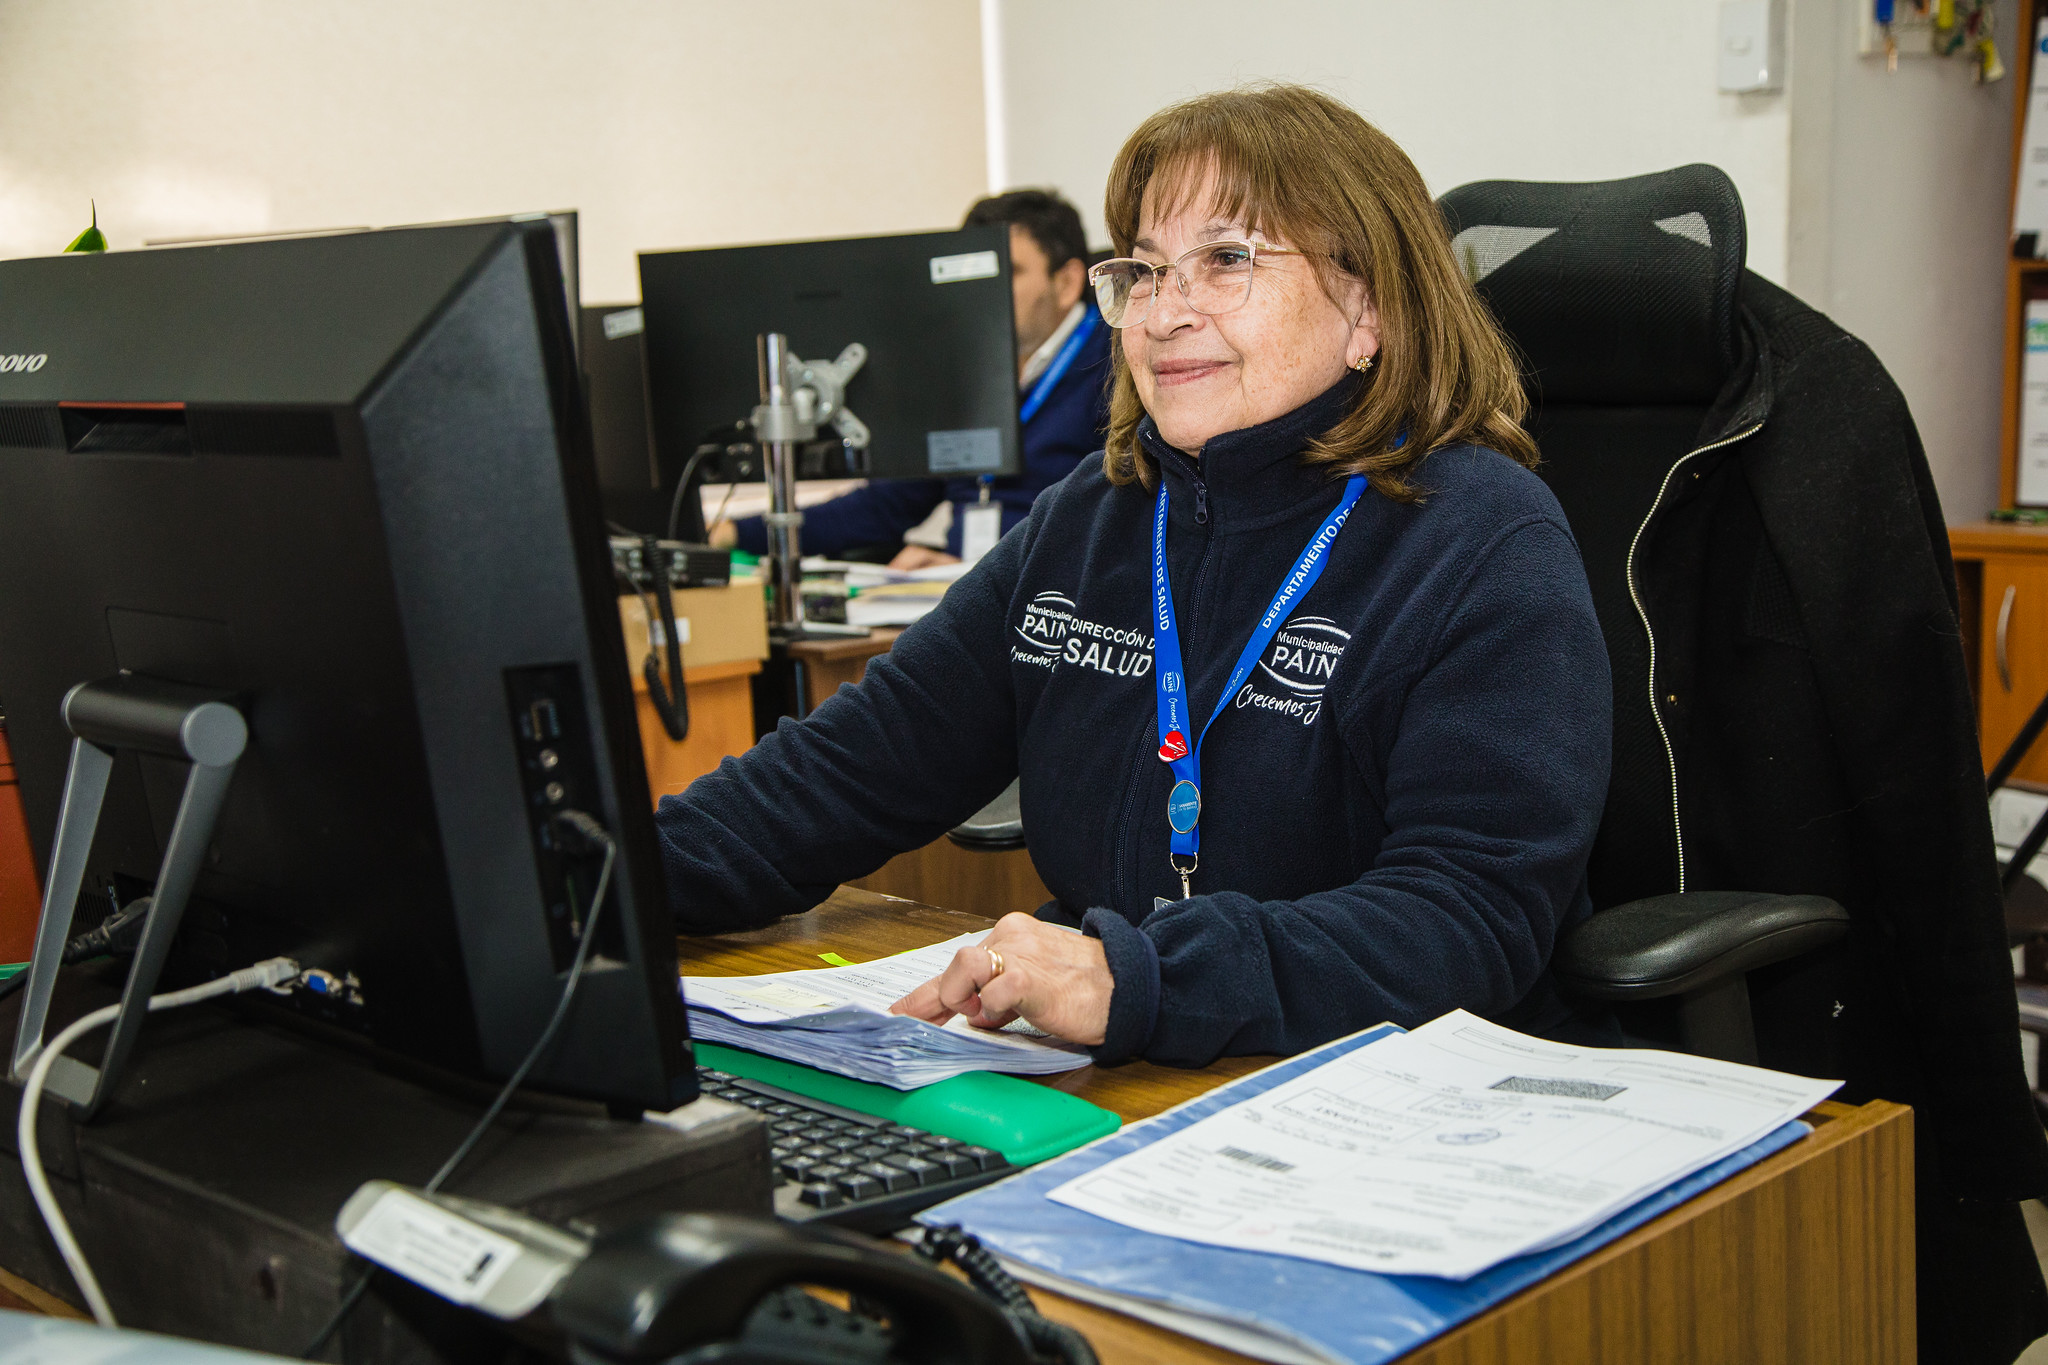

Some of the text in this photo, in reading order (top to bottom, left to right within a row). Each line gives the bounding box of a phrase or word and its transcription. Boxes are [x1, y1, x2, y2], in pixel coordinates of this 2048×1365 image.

[1156, 566, 1165, 587] DE
[1262, 525, 1338, 629] DEPARTAMENTO
[1157, 586, 1170, 631] SALUD
[1070, 618, 1156, 650] DIRECCIÓN D
[1276, 631, 1345, 656] Municipalidad
[1063, 637, 1153, 677] SALUD
[1270, 645, 1338, 680] PAIN
[1166, 671, 1174, 693] PAINE
[1236, 684, 1304, 717] Crecemos
